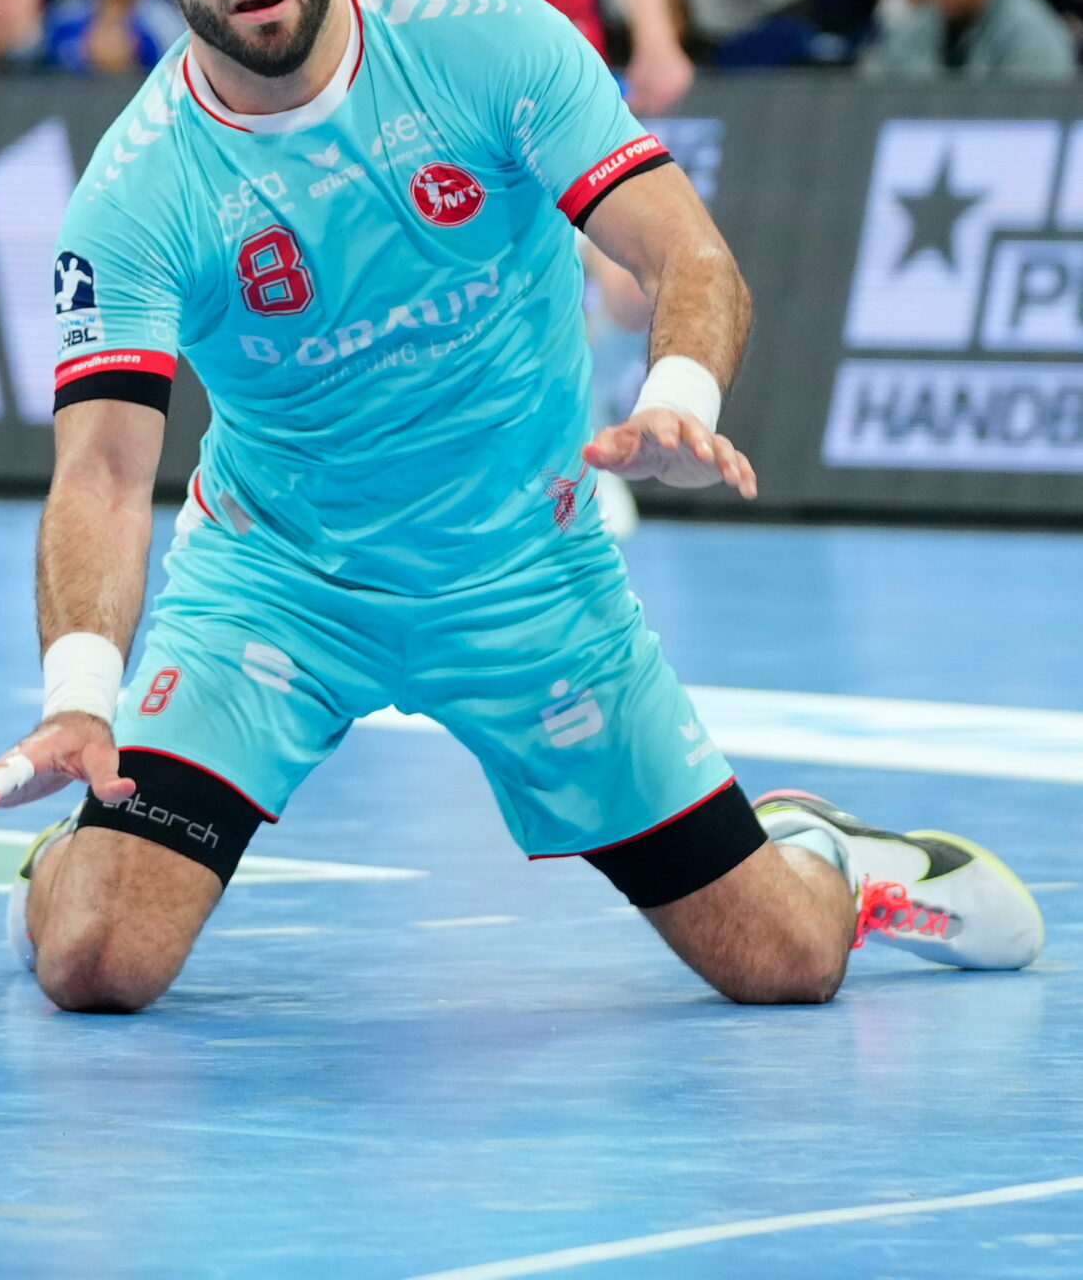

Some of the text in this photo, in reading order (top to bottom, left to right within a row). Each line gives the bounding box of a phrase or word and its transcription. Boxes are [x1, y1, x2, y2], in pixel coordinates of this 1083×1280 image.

[587, 152, 627, 187] FULLE
[236, 224, 315, 317] 8
[1009, 258, 1083, 328] P
[71, 354, 141, 372] nordhessen
[139, 666, 183, 716] 8
